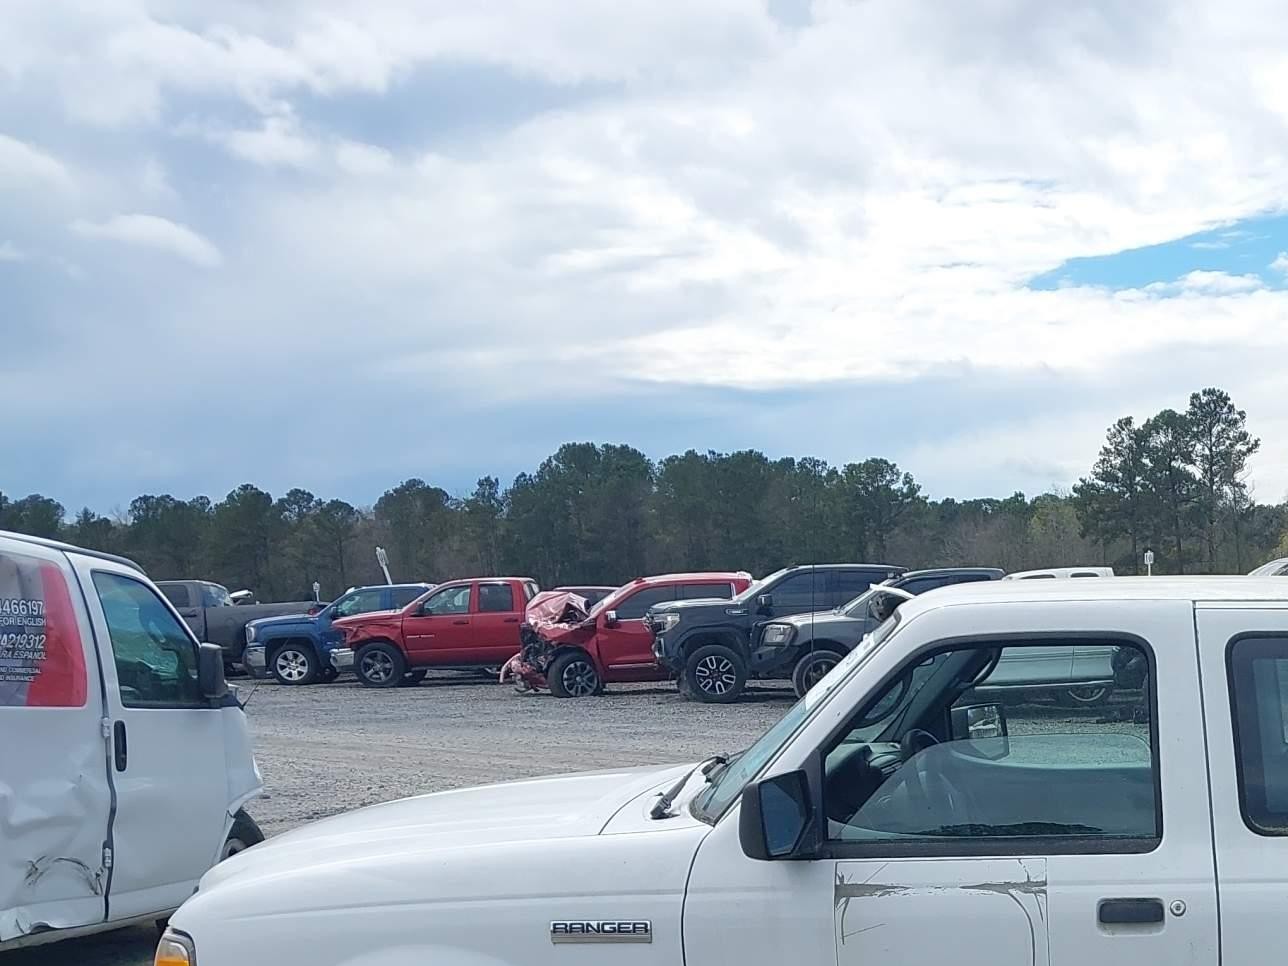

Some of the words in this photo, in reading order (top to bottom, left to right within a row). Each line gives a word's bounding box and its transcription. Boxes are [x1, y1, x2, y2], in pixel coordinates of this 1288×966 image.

[0, 599, 43, 615] 466197
[17, 617, 46, 627] ENGLISH
[0, 633, 47, 649] 4219312
[0, 650, 12, 658] RA
[552, 922, 649, 934] RANGER
